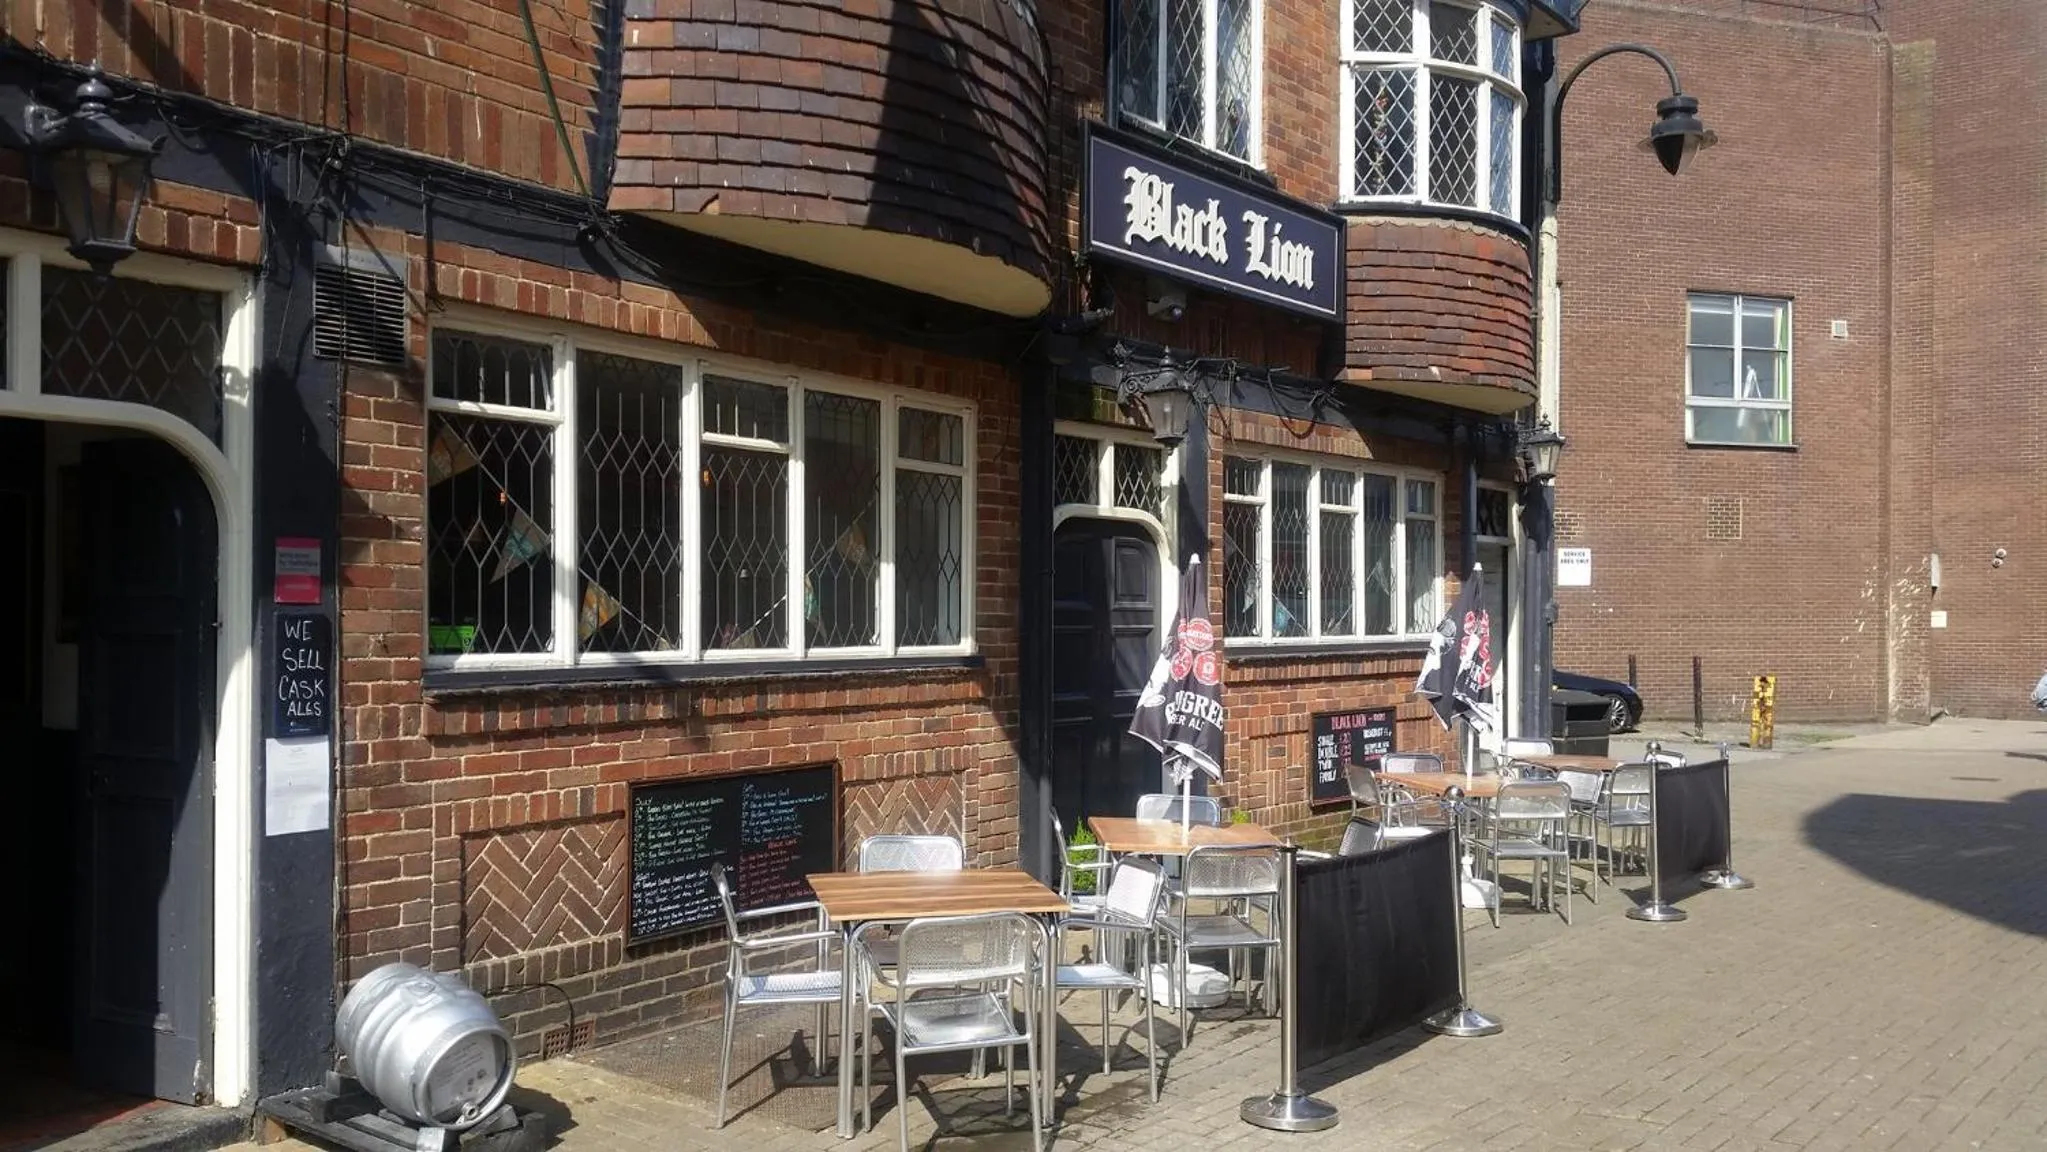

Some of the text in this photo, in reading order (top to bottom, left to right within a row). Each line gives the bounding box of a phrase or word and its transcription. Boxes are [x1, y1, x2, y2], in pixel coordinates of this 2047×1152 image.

[1124, 166, 1315, 290] Black Lion
[285, 620, 313, 641] WE
[282, 647, 324, 671] SELL
[278, 675, 325, 701] CASK
[287, 701, 322, 716] ALES
